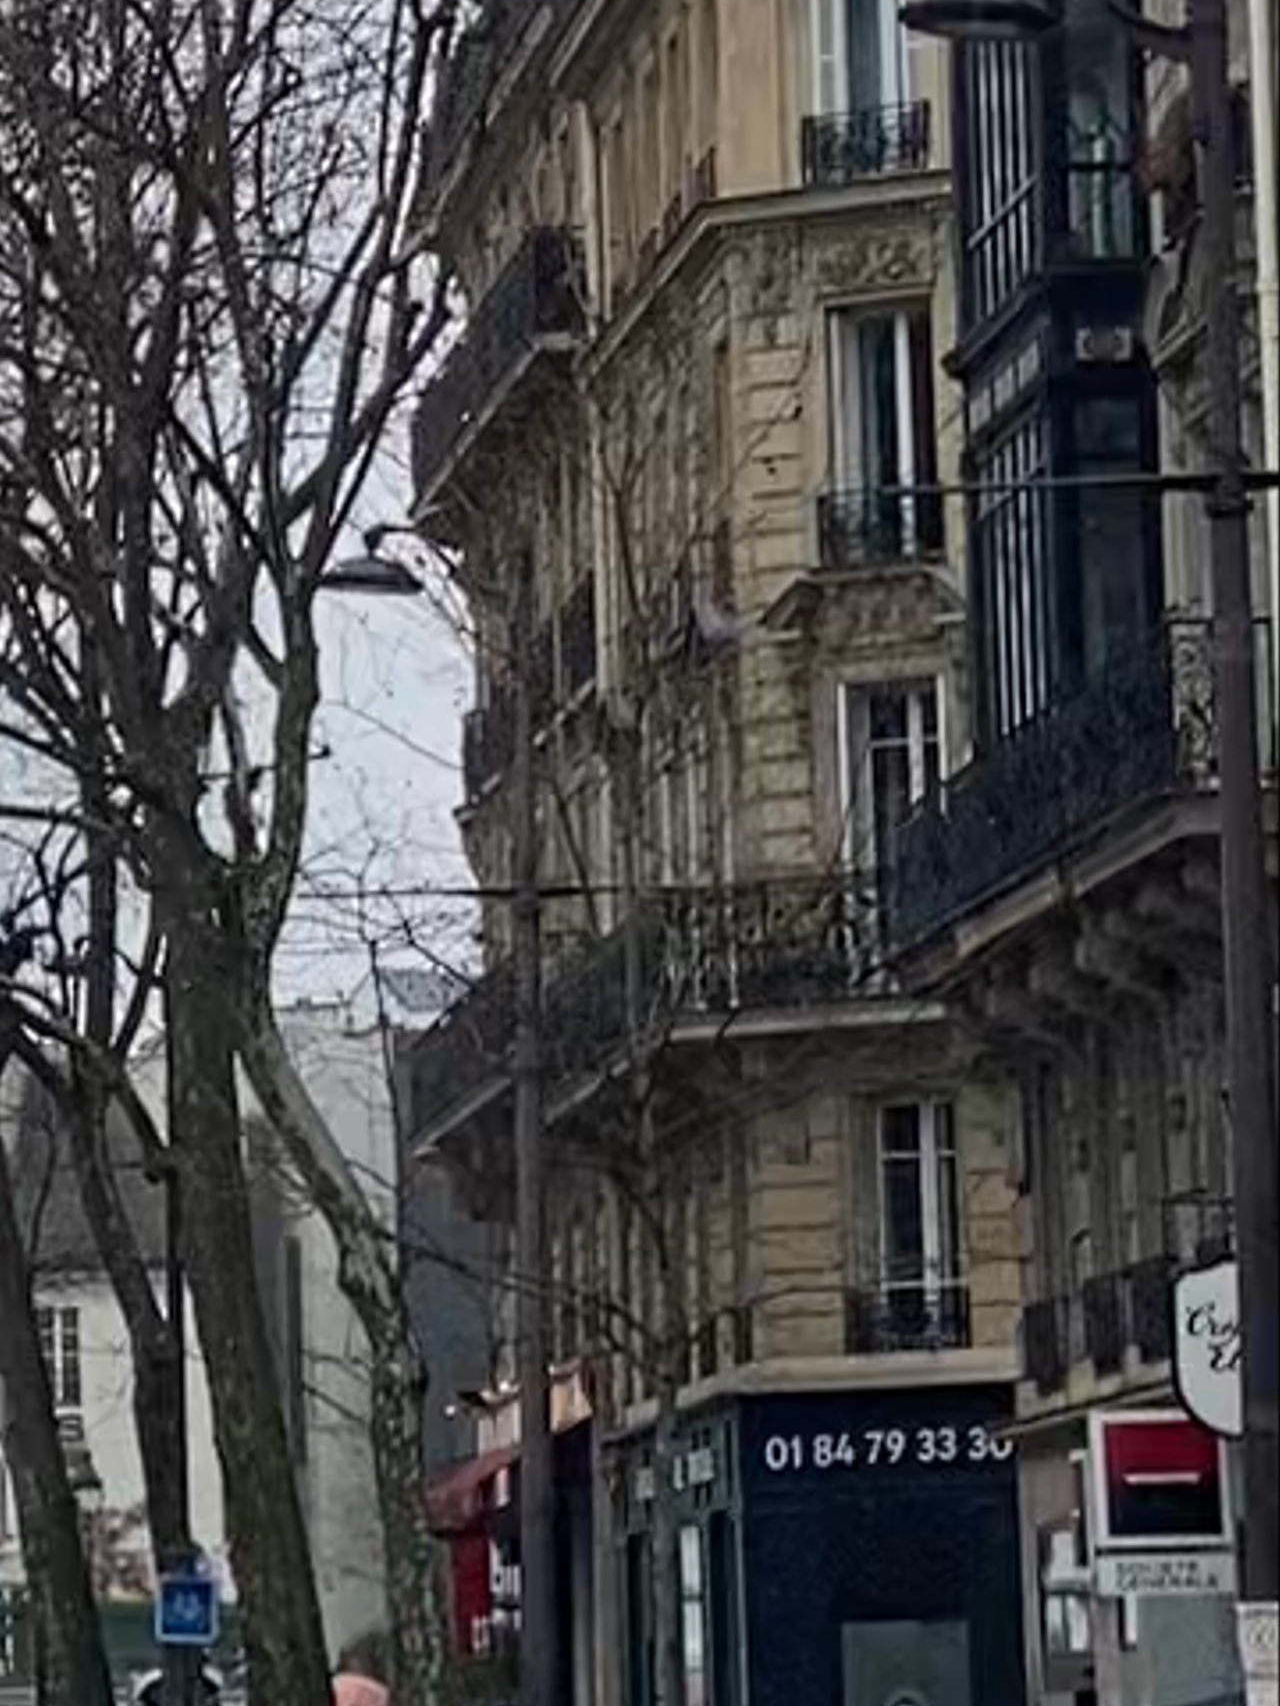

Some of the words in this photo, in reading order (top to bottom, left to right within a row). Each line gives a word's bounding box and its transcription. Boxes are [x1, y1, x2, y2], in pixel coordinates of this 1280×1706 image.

[765, 1435, 802, 1471] 01
[813, 1433, 854, 1467] 84
[865, 1428, 906, 1464] 79
[917, 1427, 957, 1462] 33
